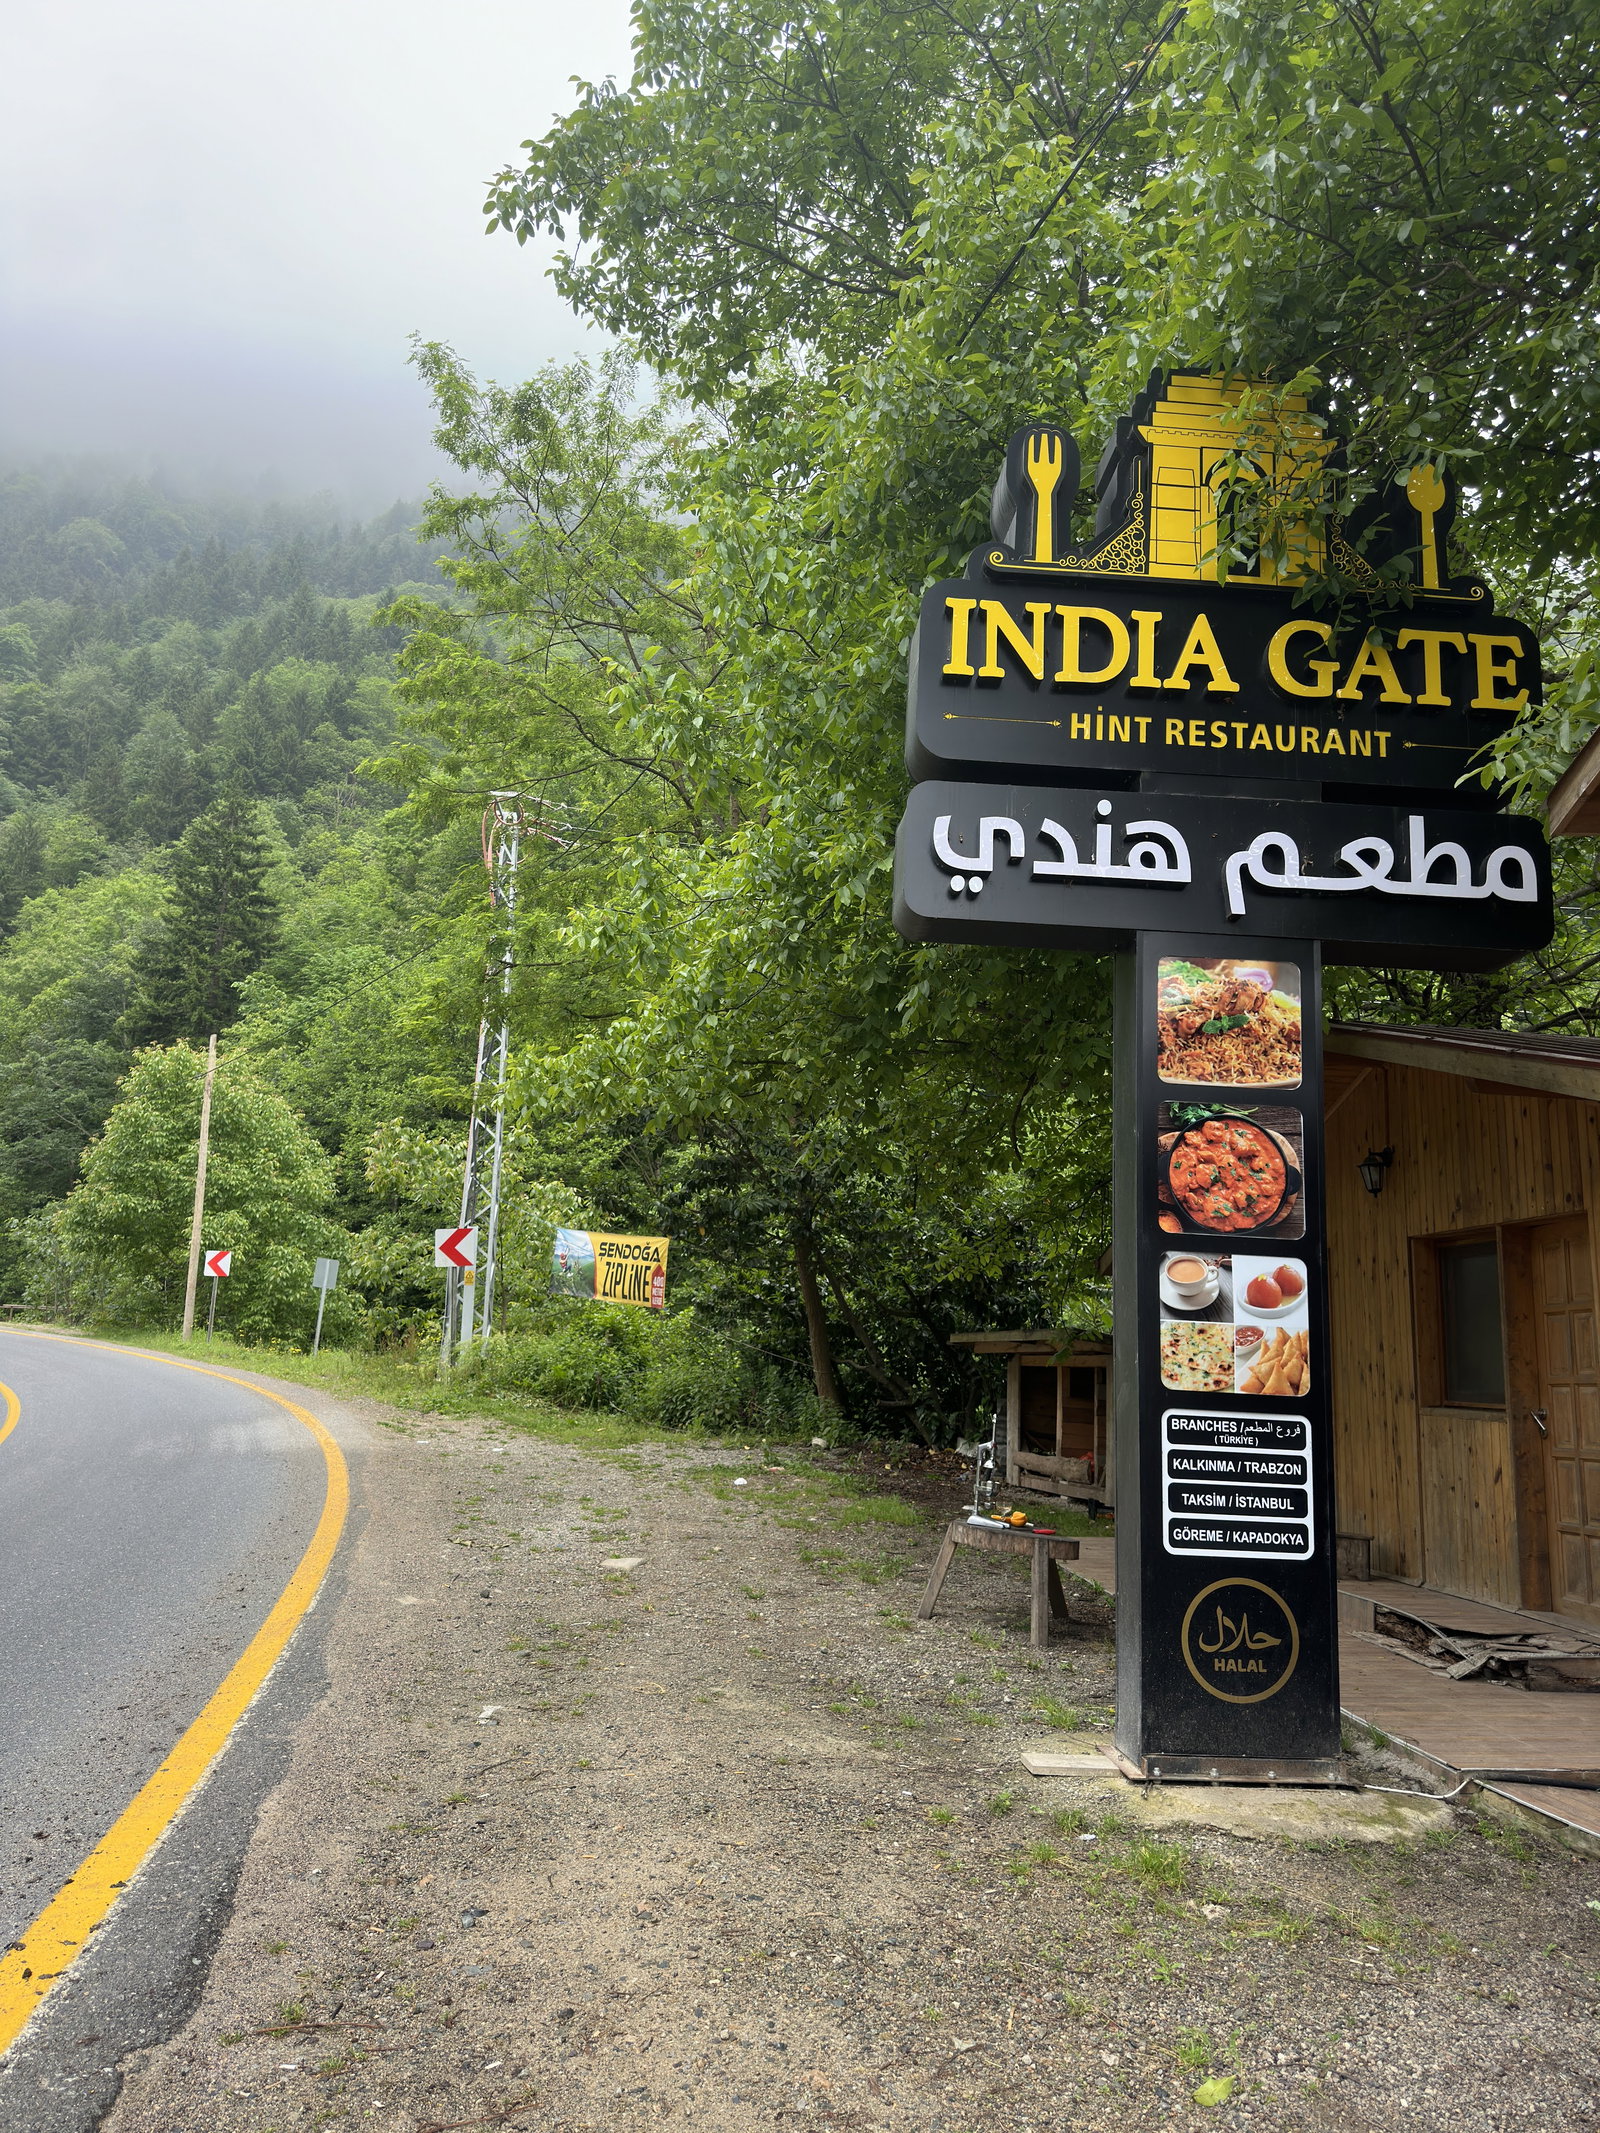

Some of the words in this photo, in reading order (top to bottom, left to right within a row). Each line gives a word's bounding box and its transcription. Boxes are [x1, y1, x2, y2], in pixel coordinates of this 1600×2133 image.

[942, 596, 1240, 693] INDIA
[1267, 619, 1530, 712] GATE
[1070, 705, 1152, 743] HİNT
[1165, 717, 1392, 758] RESTAURANT
[932, 799, 1192, 895] هندي
[1225, 815, 1538, 918] مطعم
[1171, 1418, 1238, 1433] BRANCHES
[1173, 1458, 1236, 1473] KALKINMA
[1244, 1461, 1302, 1476] TRABZON
[1182, 1492, 1226, 1507] TAKSİM
[1235, 1493, 1295, 1510] İSTANBUL
[1173, 1526, 1224, 1543] GÖREME
[1232, 1530, 1305, 1546] KAPADOKYA
[1198, 1604, 1282, 1653] حلال
[1213, 1658, 1268, 1673] HALAL
